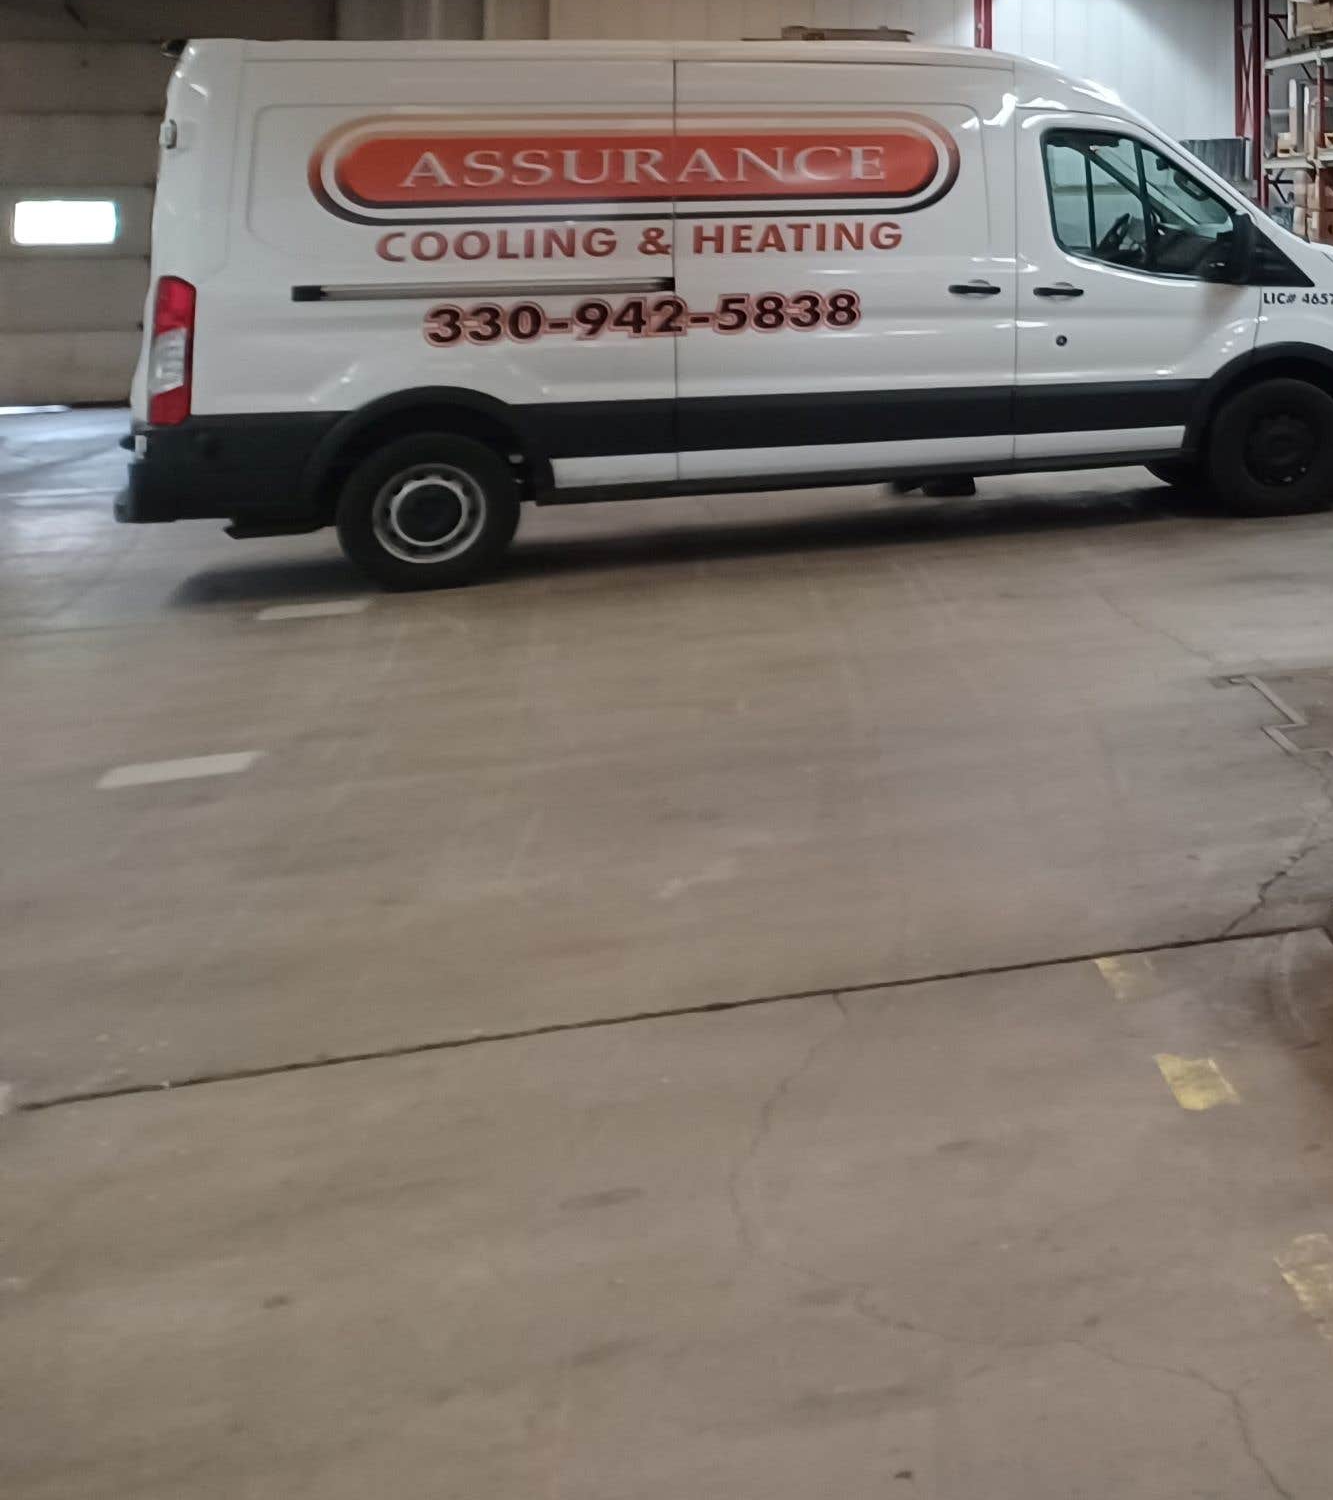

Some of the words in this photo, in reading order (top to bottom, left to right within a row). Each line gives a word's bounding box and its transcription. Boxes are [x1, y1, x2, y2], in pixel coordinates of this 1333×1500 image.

[397, 146, 887, 189] ASSURANCE
[376, 226, 618, 262] COOLING
[637, 226, 671, 255] &
[693, 221, 903, 255] HEATING
[425, 290, 860, 346] 330-942-5838
[1263, 292, 1296, 305] LIC#
